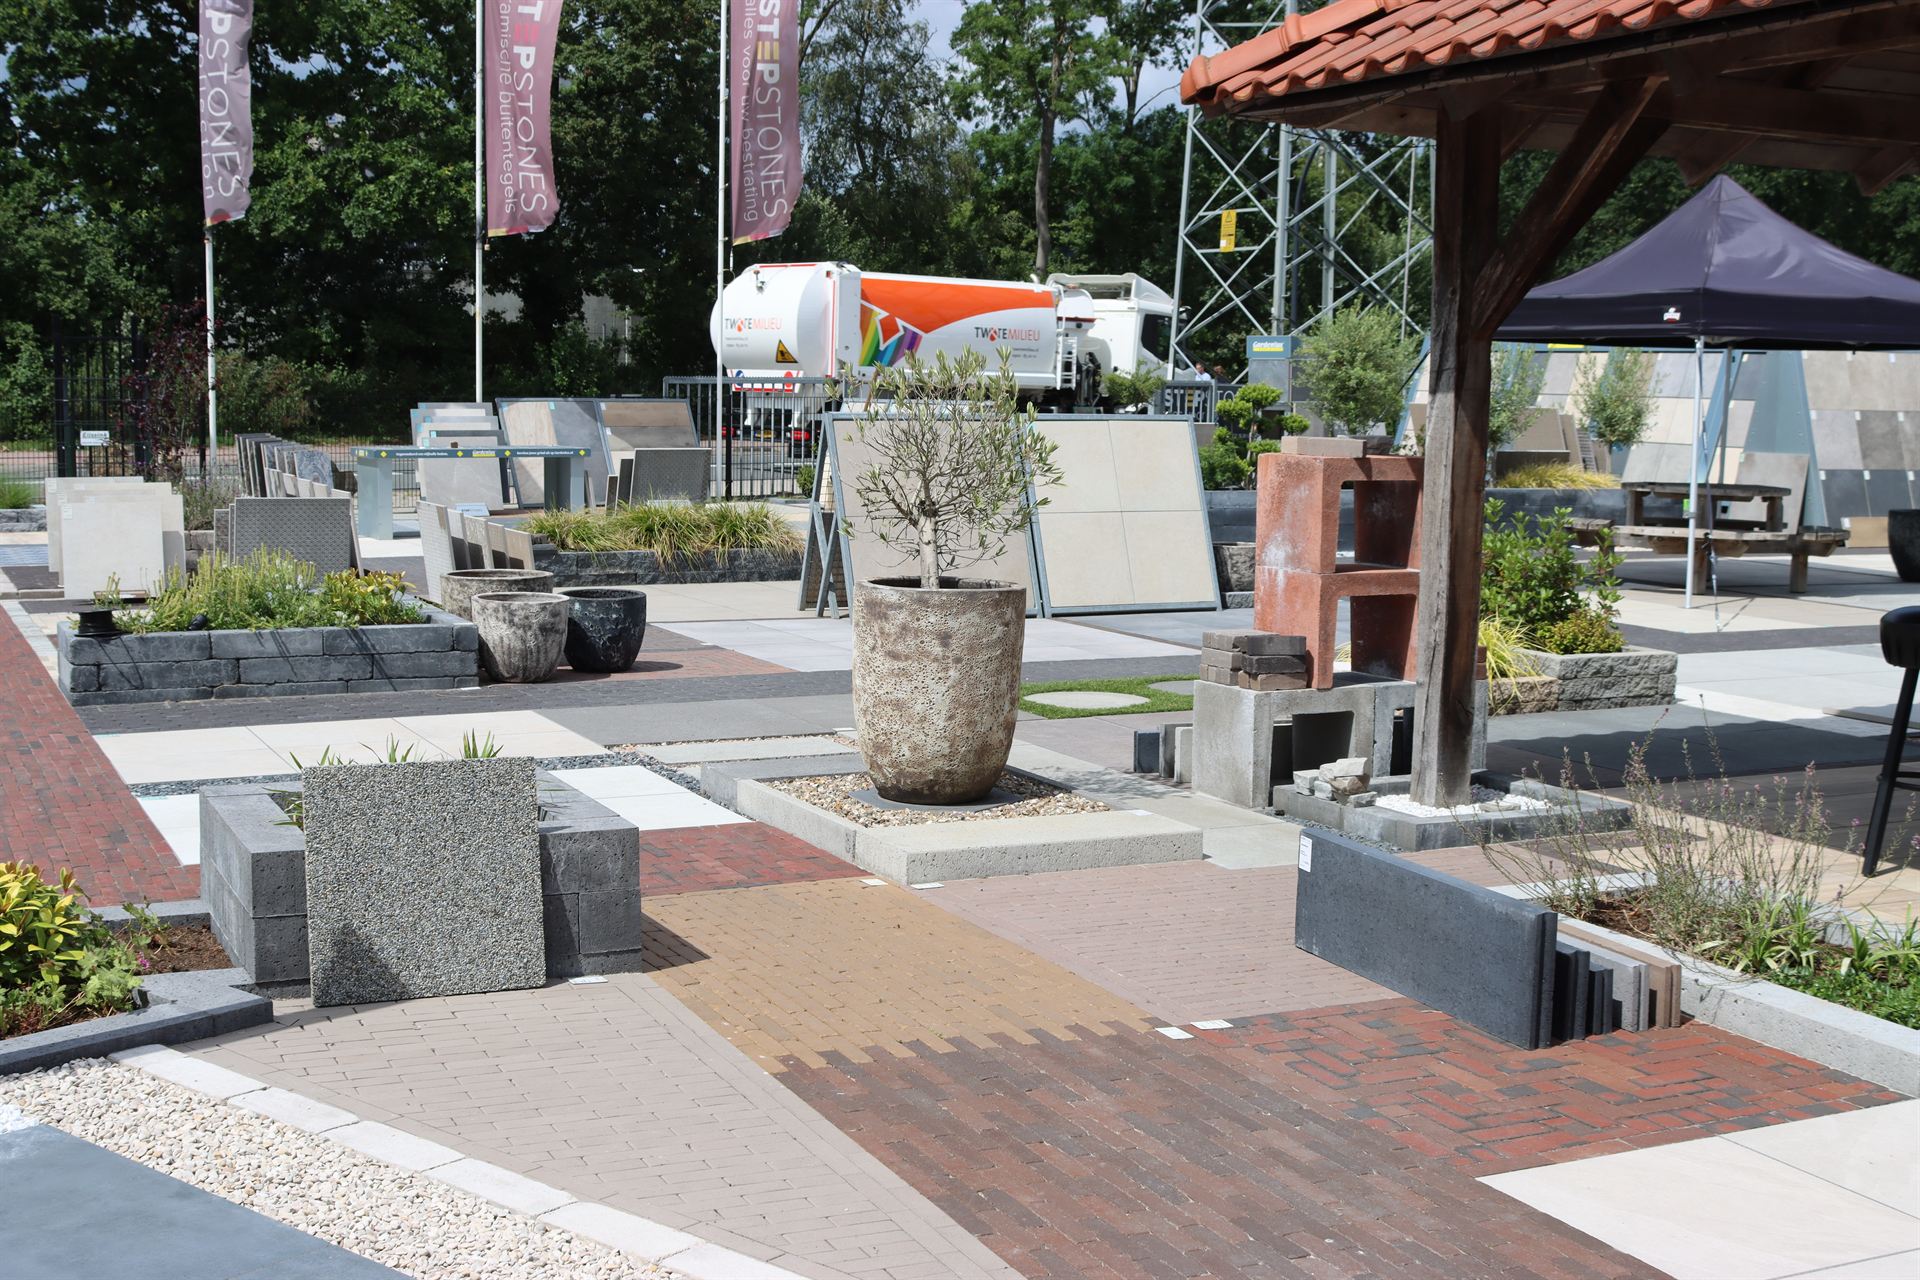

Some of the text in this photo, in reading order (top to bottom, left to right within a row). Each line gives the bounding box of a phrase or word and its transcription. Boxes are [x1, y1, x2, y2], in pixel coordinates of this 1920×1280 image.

[499, 91, 518, 213] buitentegels
[755, 0, 788, 218] STEPSTONES
[742, 128, 758, 222] bestrating
